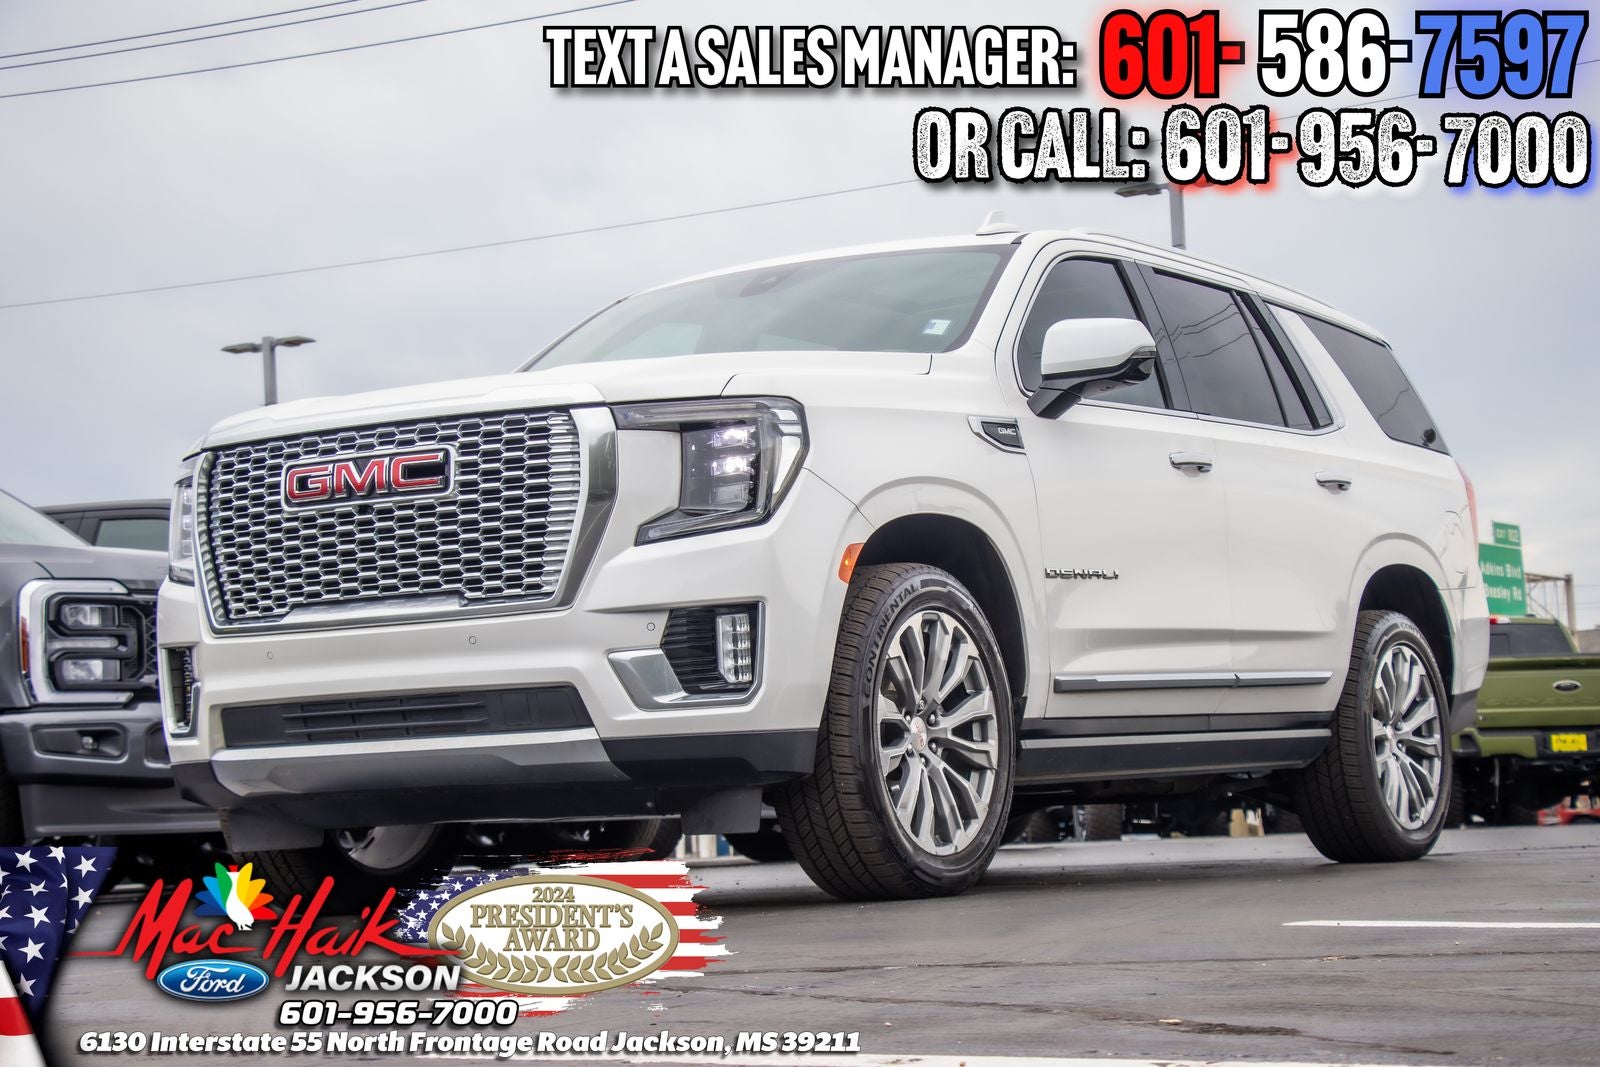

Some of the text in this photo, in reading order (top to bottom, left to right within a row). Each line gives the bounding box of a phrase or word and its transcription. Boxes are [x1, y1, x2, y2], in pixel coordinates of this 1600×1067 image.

[997, 427, 1017, 436] GMC
[287, 451, 446, 503] GMC
[1508, 529, 1520, 543] 102
[1044, 567, 1119, 580] DENALI
[1480, 560, 1521, 580] Adkins Blvd
[1512, 586, 1523, 602] Rd
[865, 583, 919, 699] CONTINENTAL
